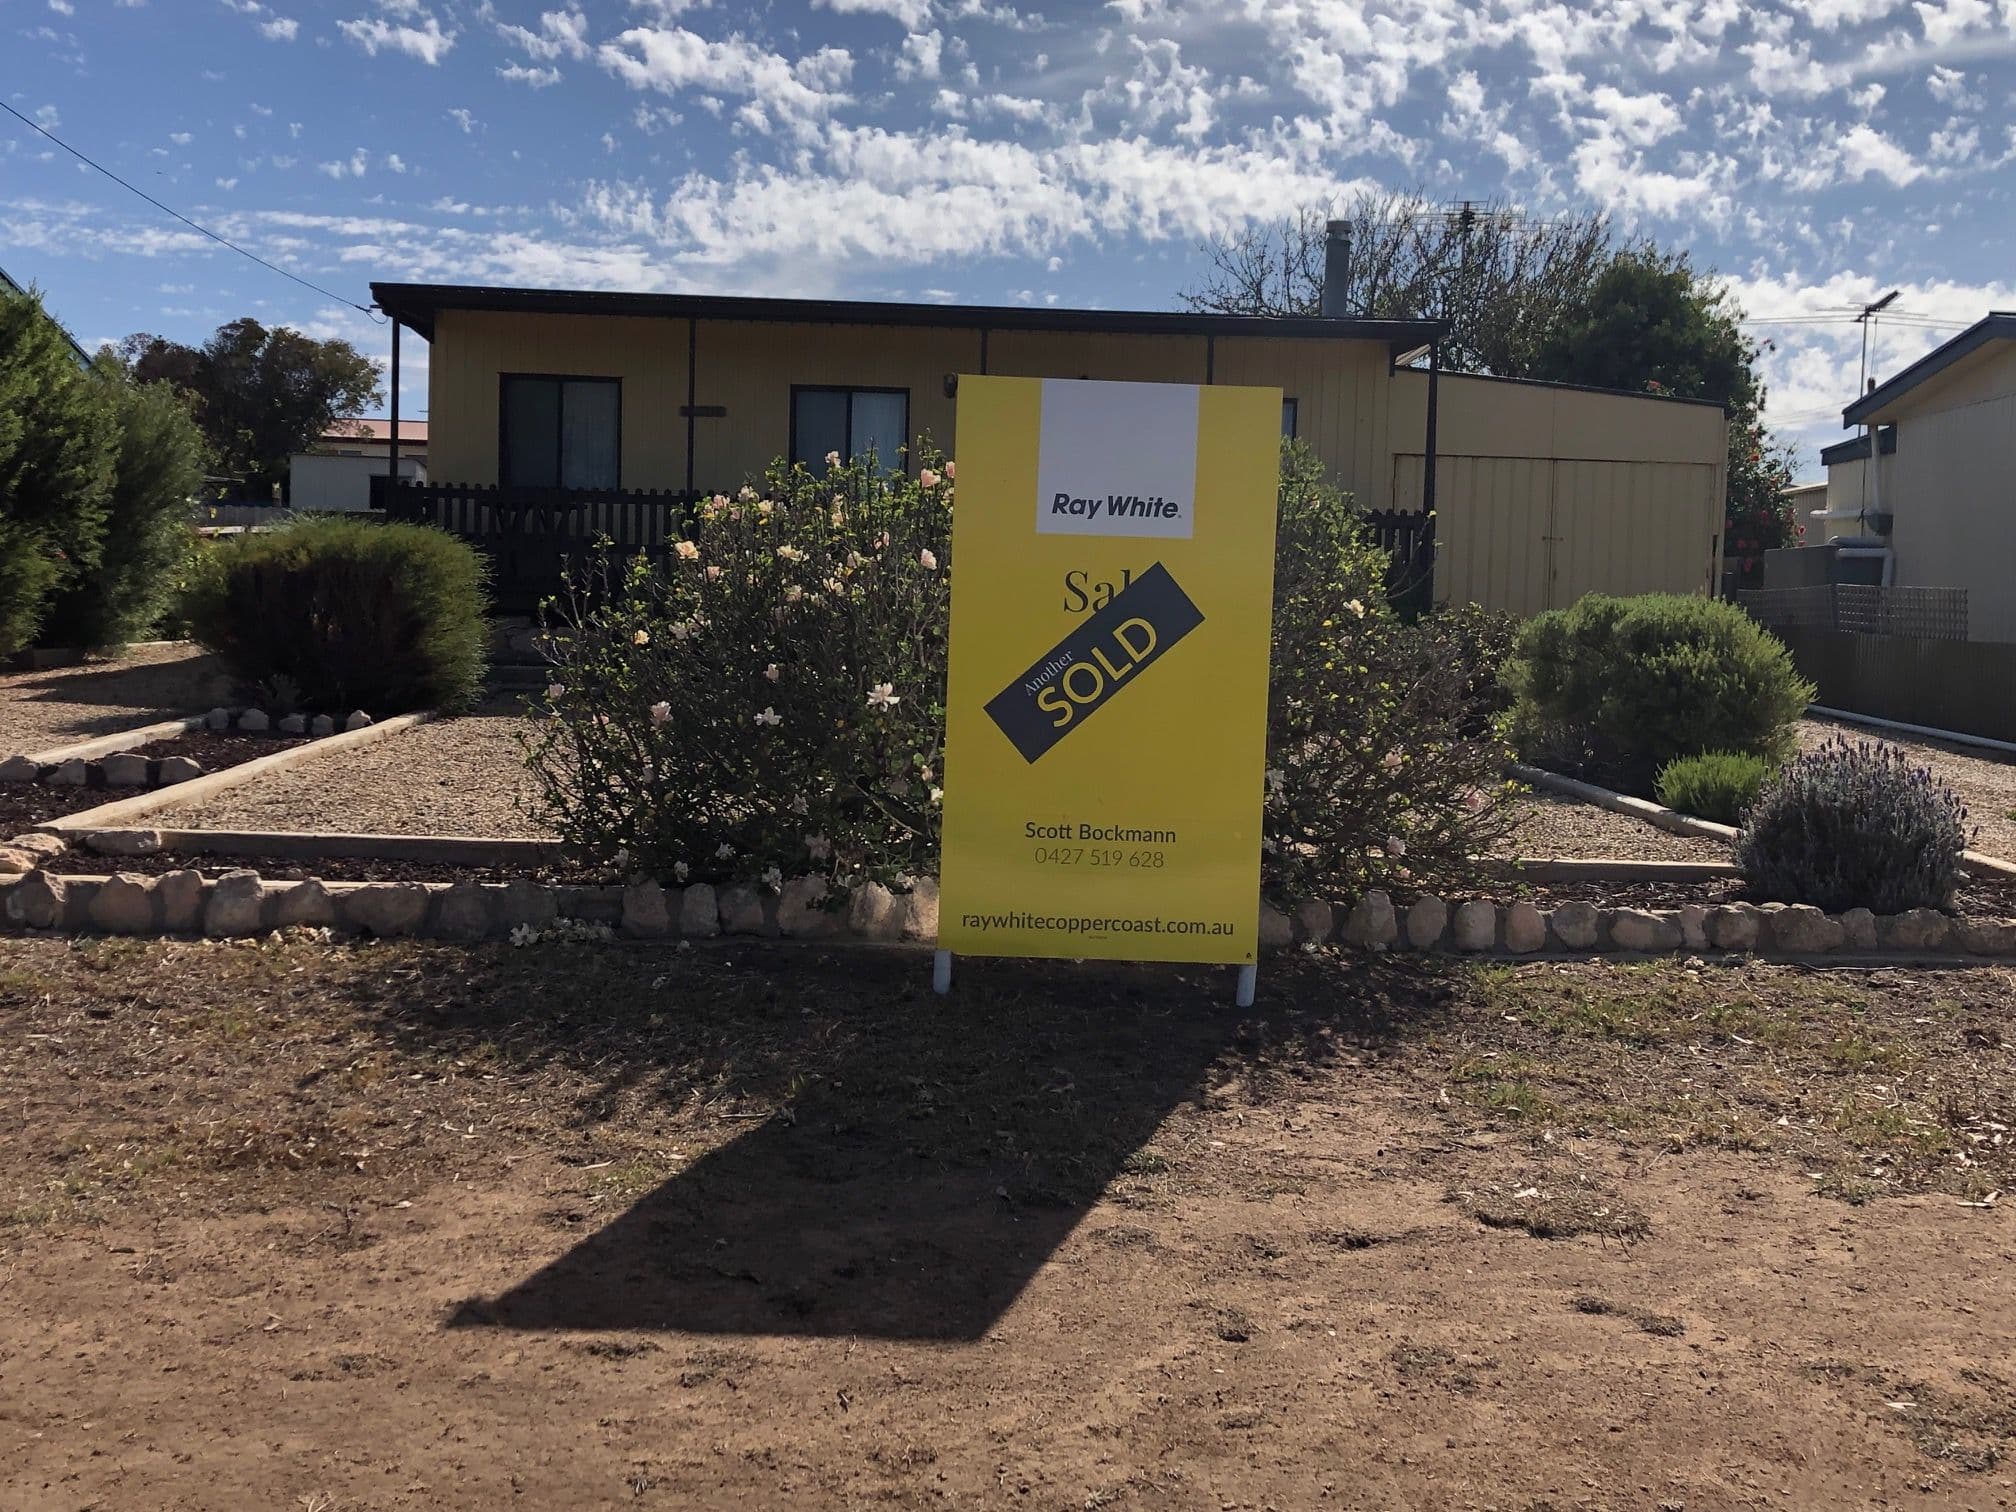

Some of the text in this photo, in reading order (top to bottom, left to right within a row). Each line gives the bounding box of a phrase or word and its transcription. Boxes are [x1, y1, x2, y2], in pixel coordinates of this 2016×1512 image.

[1052, 493, 1102, 520] Ray
[1025, 650, 1073, 696] Another
[1037, 617, 1157, 728] SOLD
[1025, 821, 1177, 843] Scott Bockmann
[1034, 846, 1165, 868] 0427 519 628
[962, 910, 1235, 936] raywhitecoppercoast.com.au
